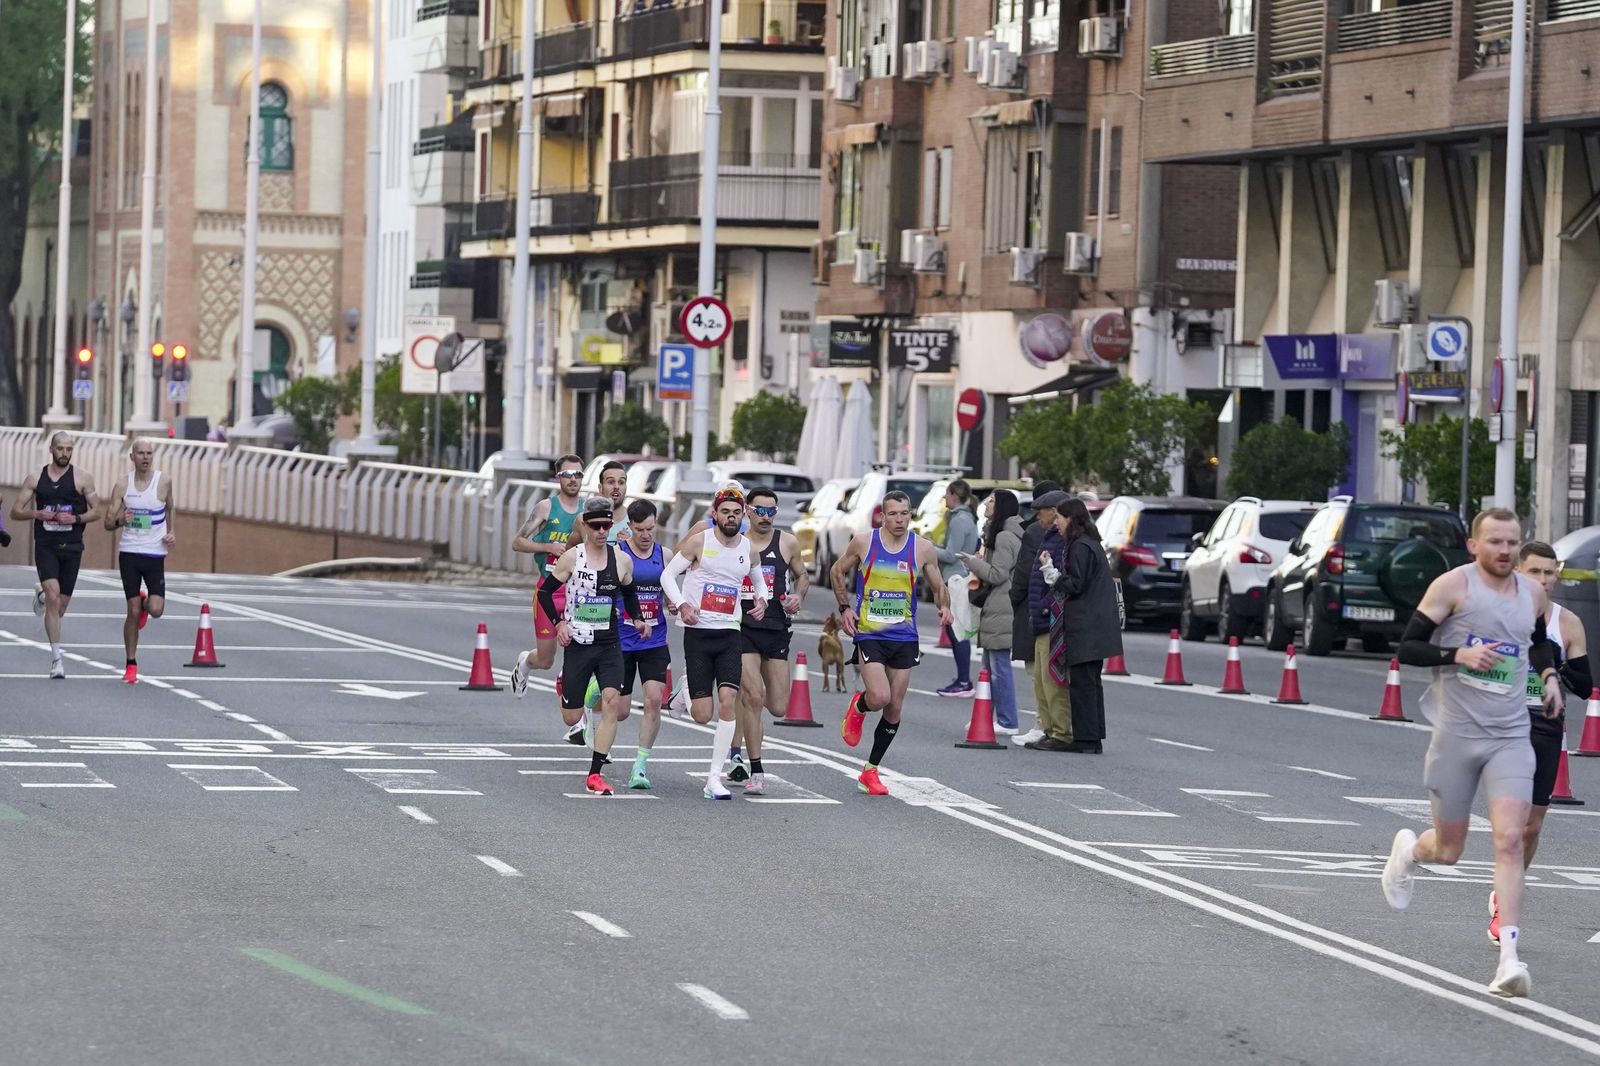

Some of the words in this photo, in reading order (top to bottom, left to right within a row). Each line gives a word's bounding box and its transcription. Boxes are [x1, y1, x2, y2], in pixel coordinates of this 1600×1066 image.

[891, 332, 949, 347] TINTE
[663, 349, 686, 379] P
[577, 570, 595, 582] TRC
[716, 586, 736, 594] ZURICH
[869, 607, 904, 616] MATTEWS
